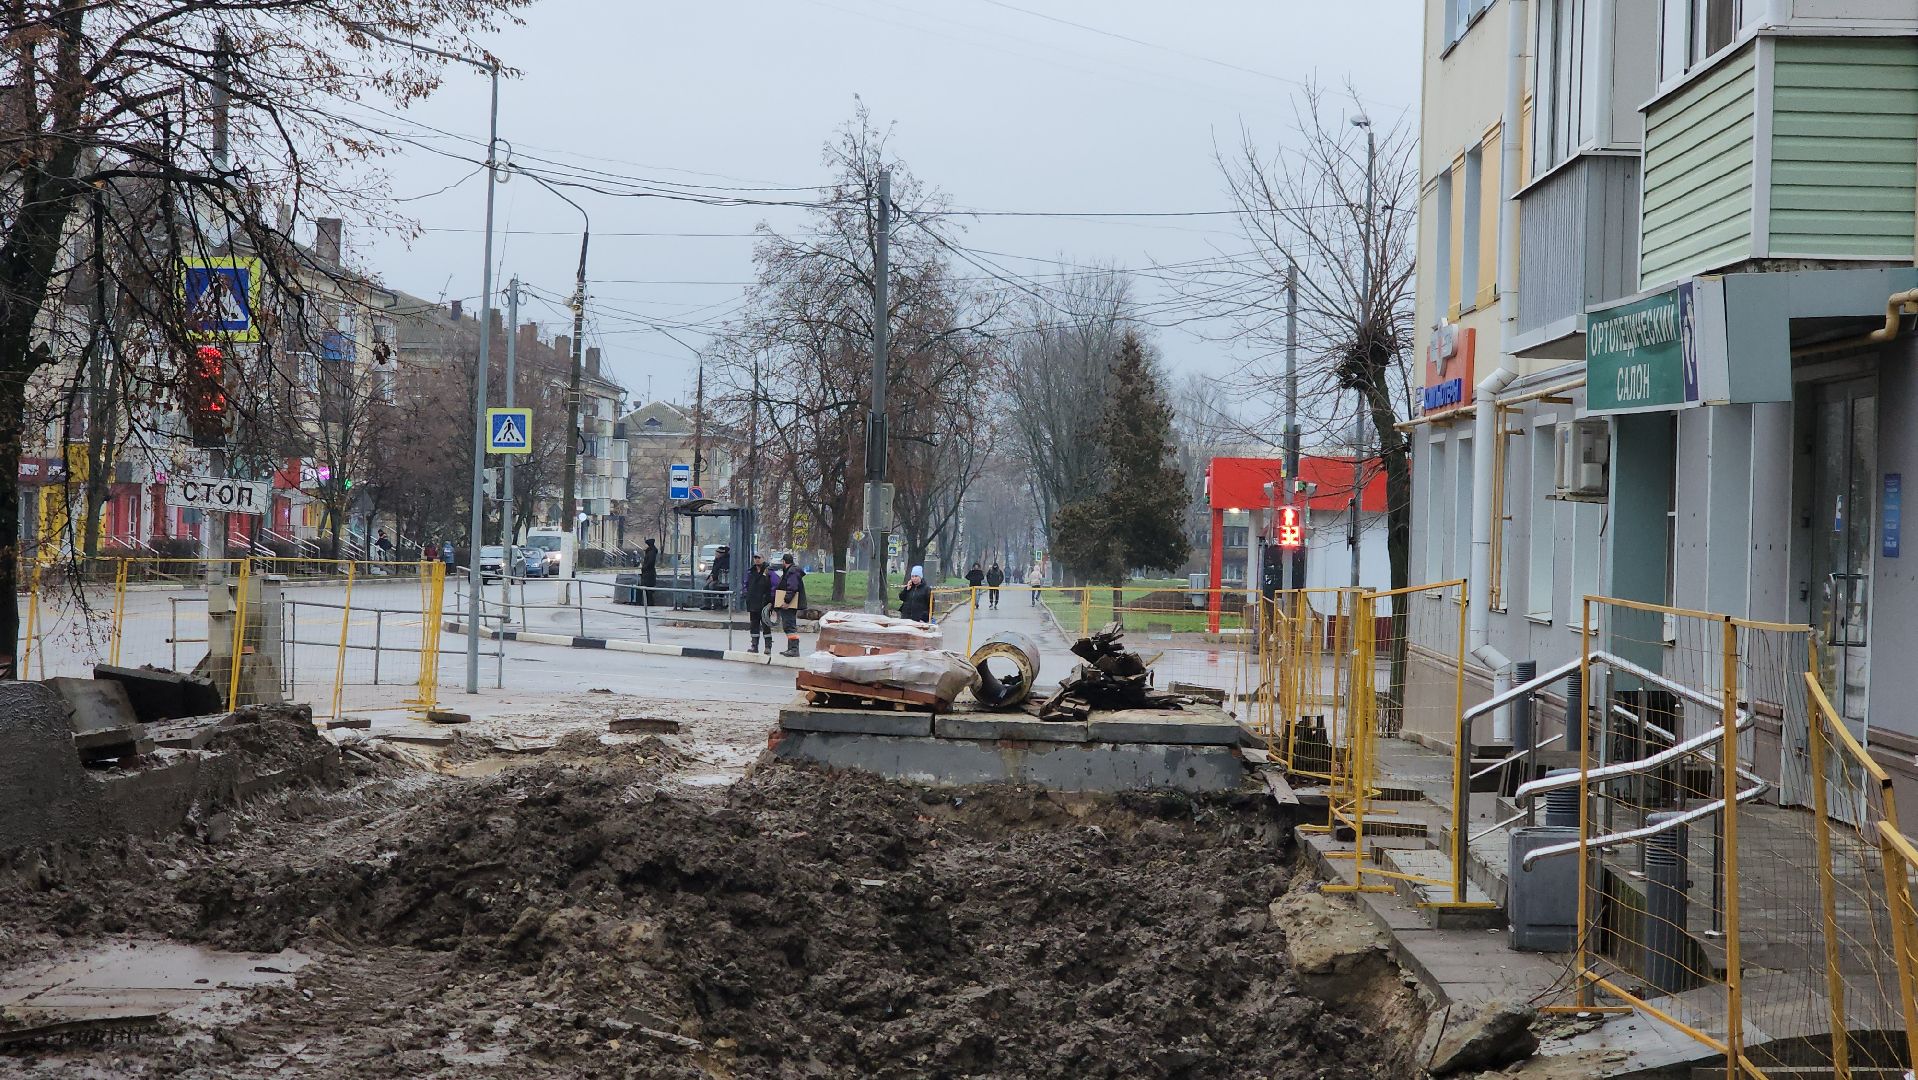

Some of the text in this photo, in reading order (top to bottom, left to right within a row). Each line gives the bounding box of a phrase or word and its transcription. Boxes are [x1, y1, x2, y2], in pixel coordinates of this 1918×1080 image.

[1590, 296, 1676, 357] ОРТОПЕДИЧЕСКИЙ
[1617, 363, 1650, 401] САЛОН
[183, 481, 253, 507] СТОП
[1280, 526, 1299, 545] 32
